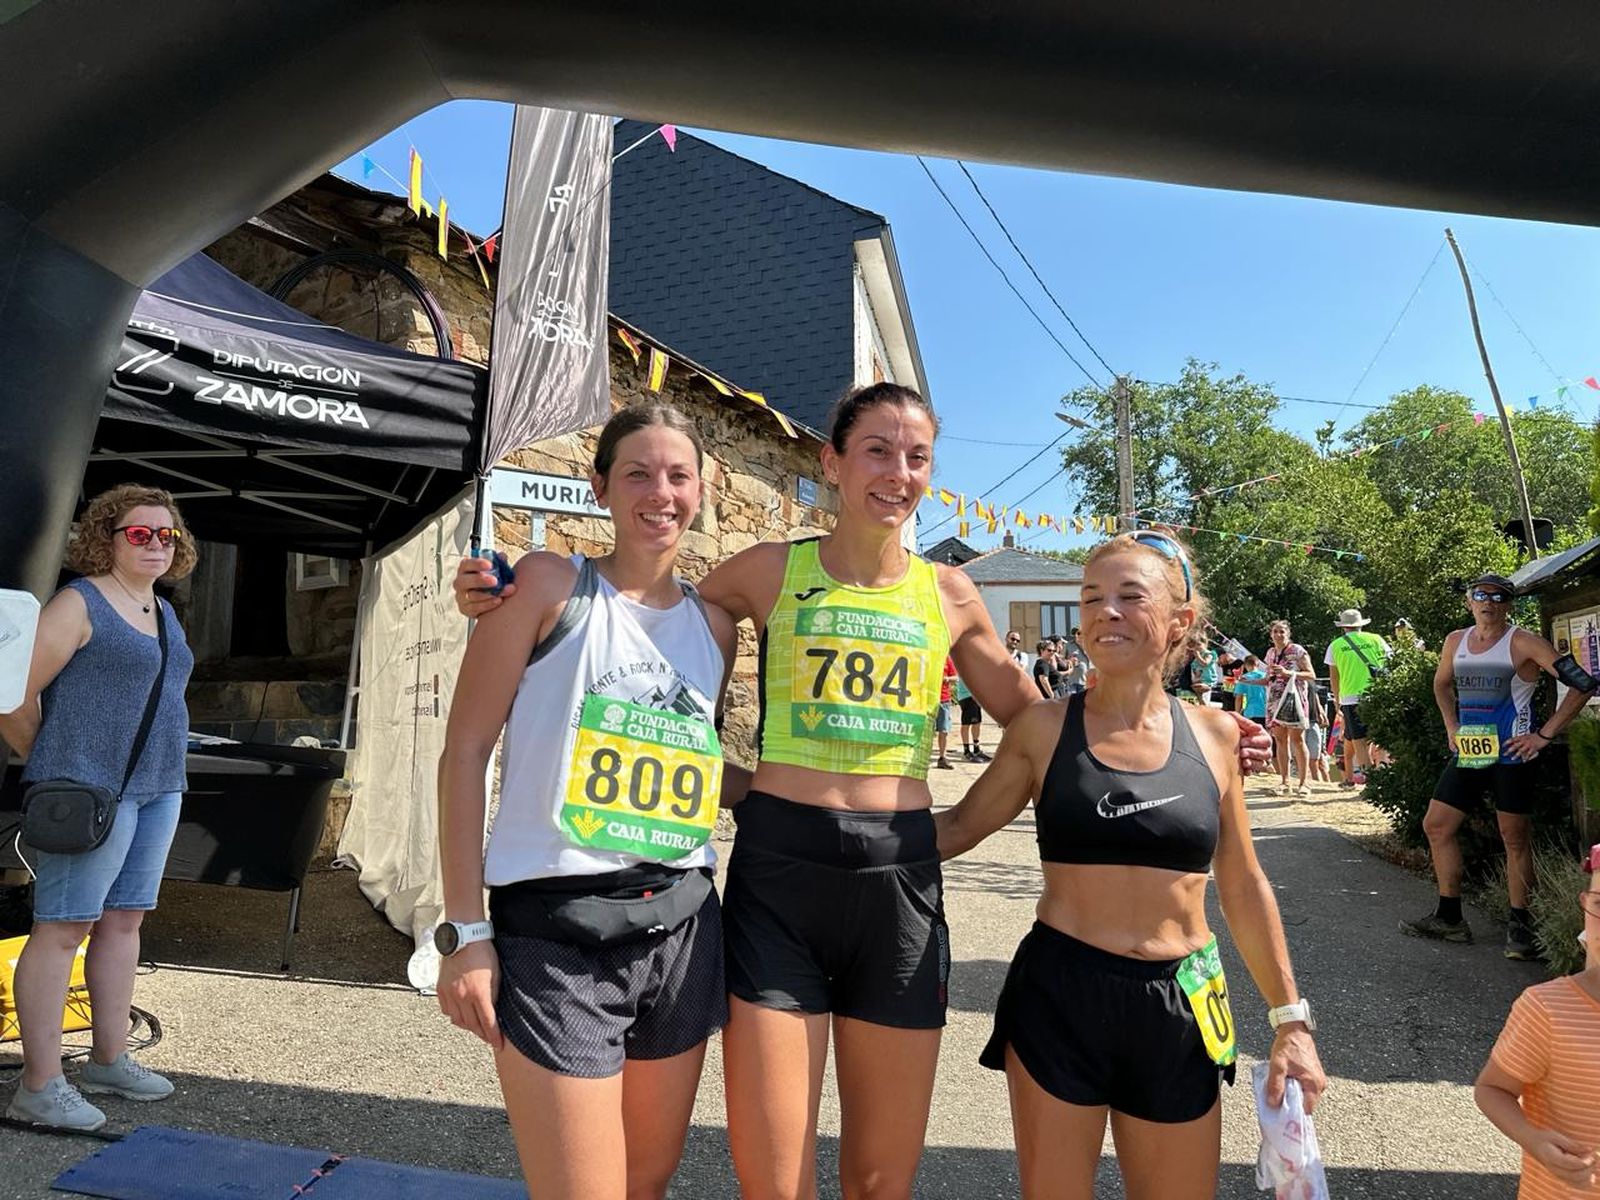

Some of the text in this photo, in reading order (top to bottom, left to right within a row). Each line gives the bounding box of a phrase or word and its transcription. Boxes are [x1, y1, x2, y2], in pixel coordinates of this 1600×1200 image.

[194, 376, 370, 429] ZAMORA
[836, 623, 913, 643] CAJA RURAL
[806, 648, 912, 707] 784
[627, 724, 708, 750] CAJA RURAL
[827, 714, 916, 736] CAJA RURAL
[585, 748, 704, 819] 809
[607, 822, 700, 850] CAJA RURAL
